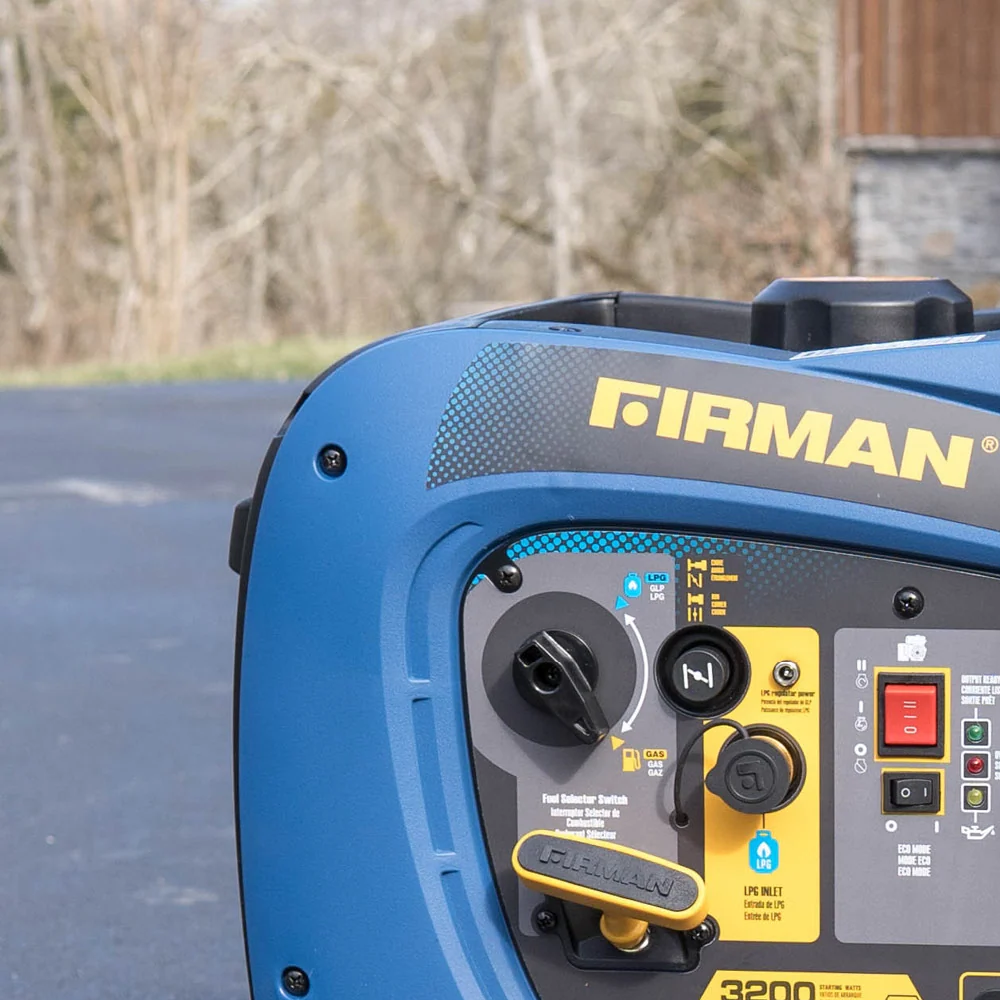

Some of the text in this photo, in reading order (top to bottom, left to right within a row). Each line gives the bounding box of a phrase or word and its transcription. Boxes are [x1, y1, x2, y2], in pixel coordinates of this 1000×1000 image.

[650, 593, 664, 601] LPG
[542, 794, 628, 805] Fuel Selector Switch
[898, 844, 911, 854] ECO
[756, 859, 771, 869] LPG
[918, 856, 931, 865] ECO
[539, 844, 675, 896] FIRMAN
[898, 866, 911, 876] ECO
[744, 886, 783, 896] LPG INLET
[744, 900, 785, 909] Entrada de LPG
[744, 912, 781, 921] Entrée de LPG
